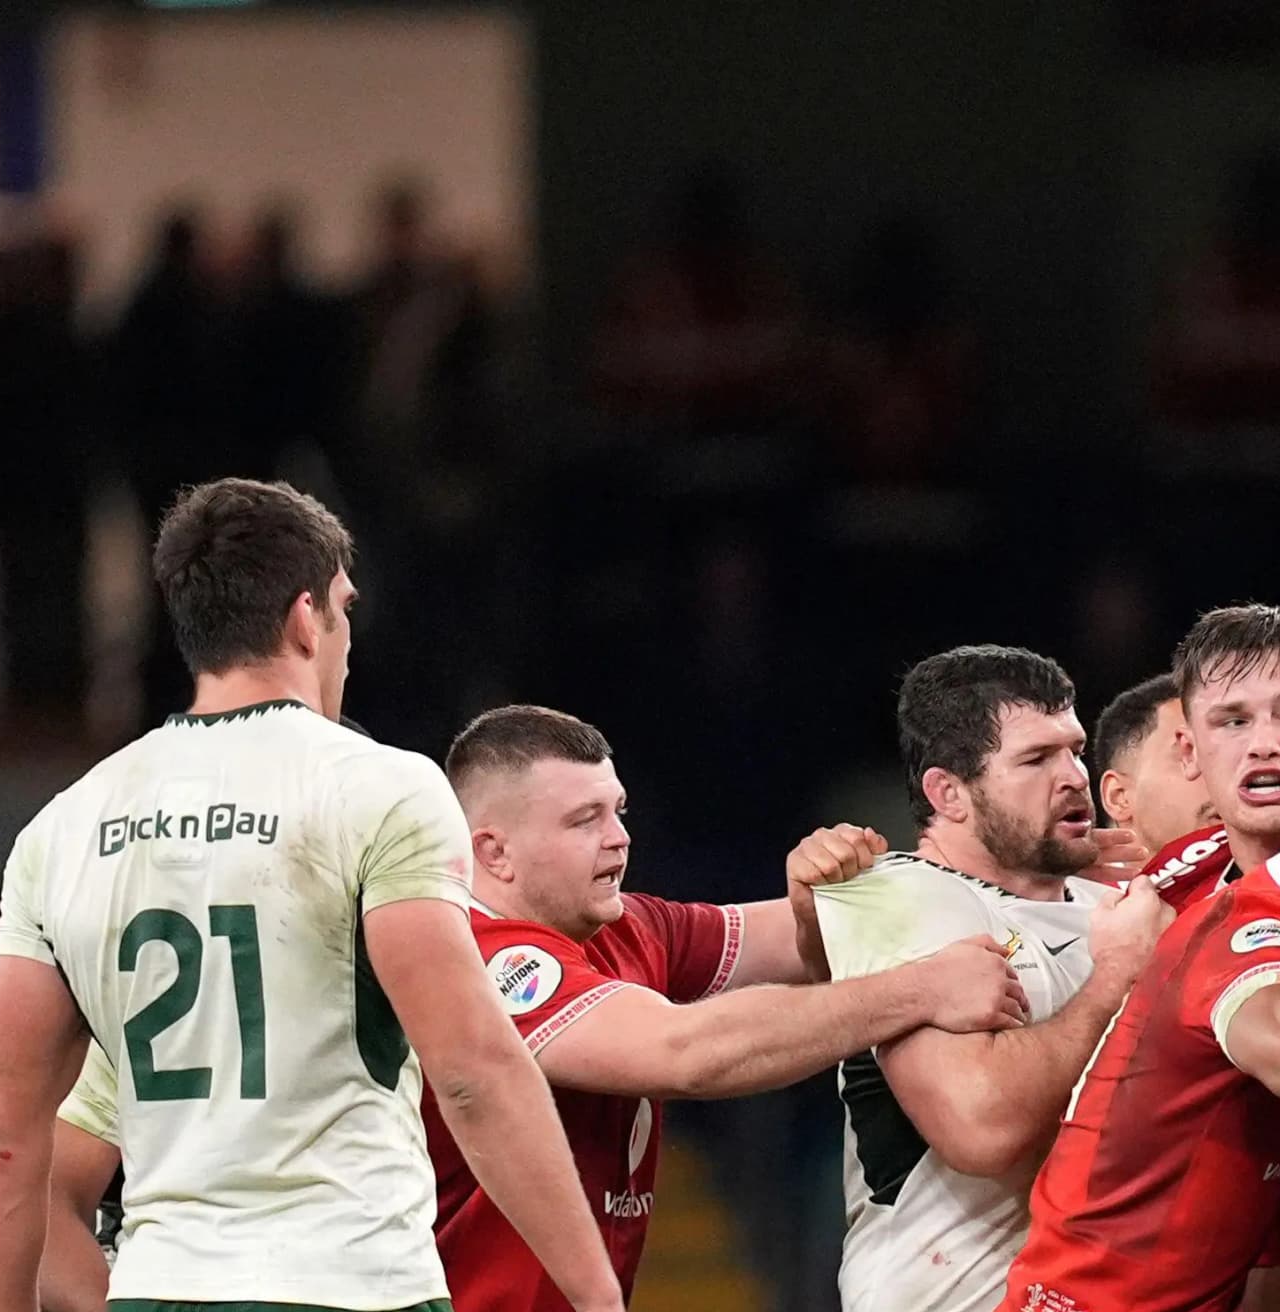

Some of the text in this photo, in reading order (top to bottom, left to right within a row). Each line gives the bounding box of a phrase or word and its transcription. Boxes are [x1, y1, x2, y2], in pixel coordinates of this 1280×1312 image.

[99, 803, 279, 857] Pick n Pay
[118, 904, 267, 1102] 21
[499, 958, 542, 998] NATIONS
